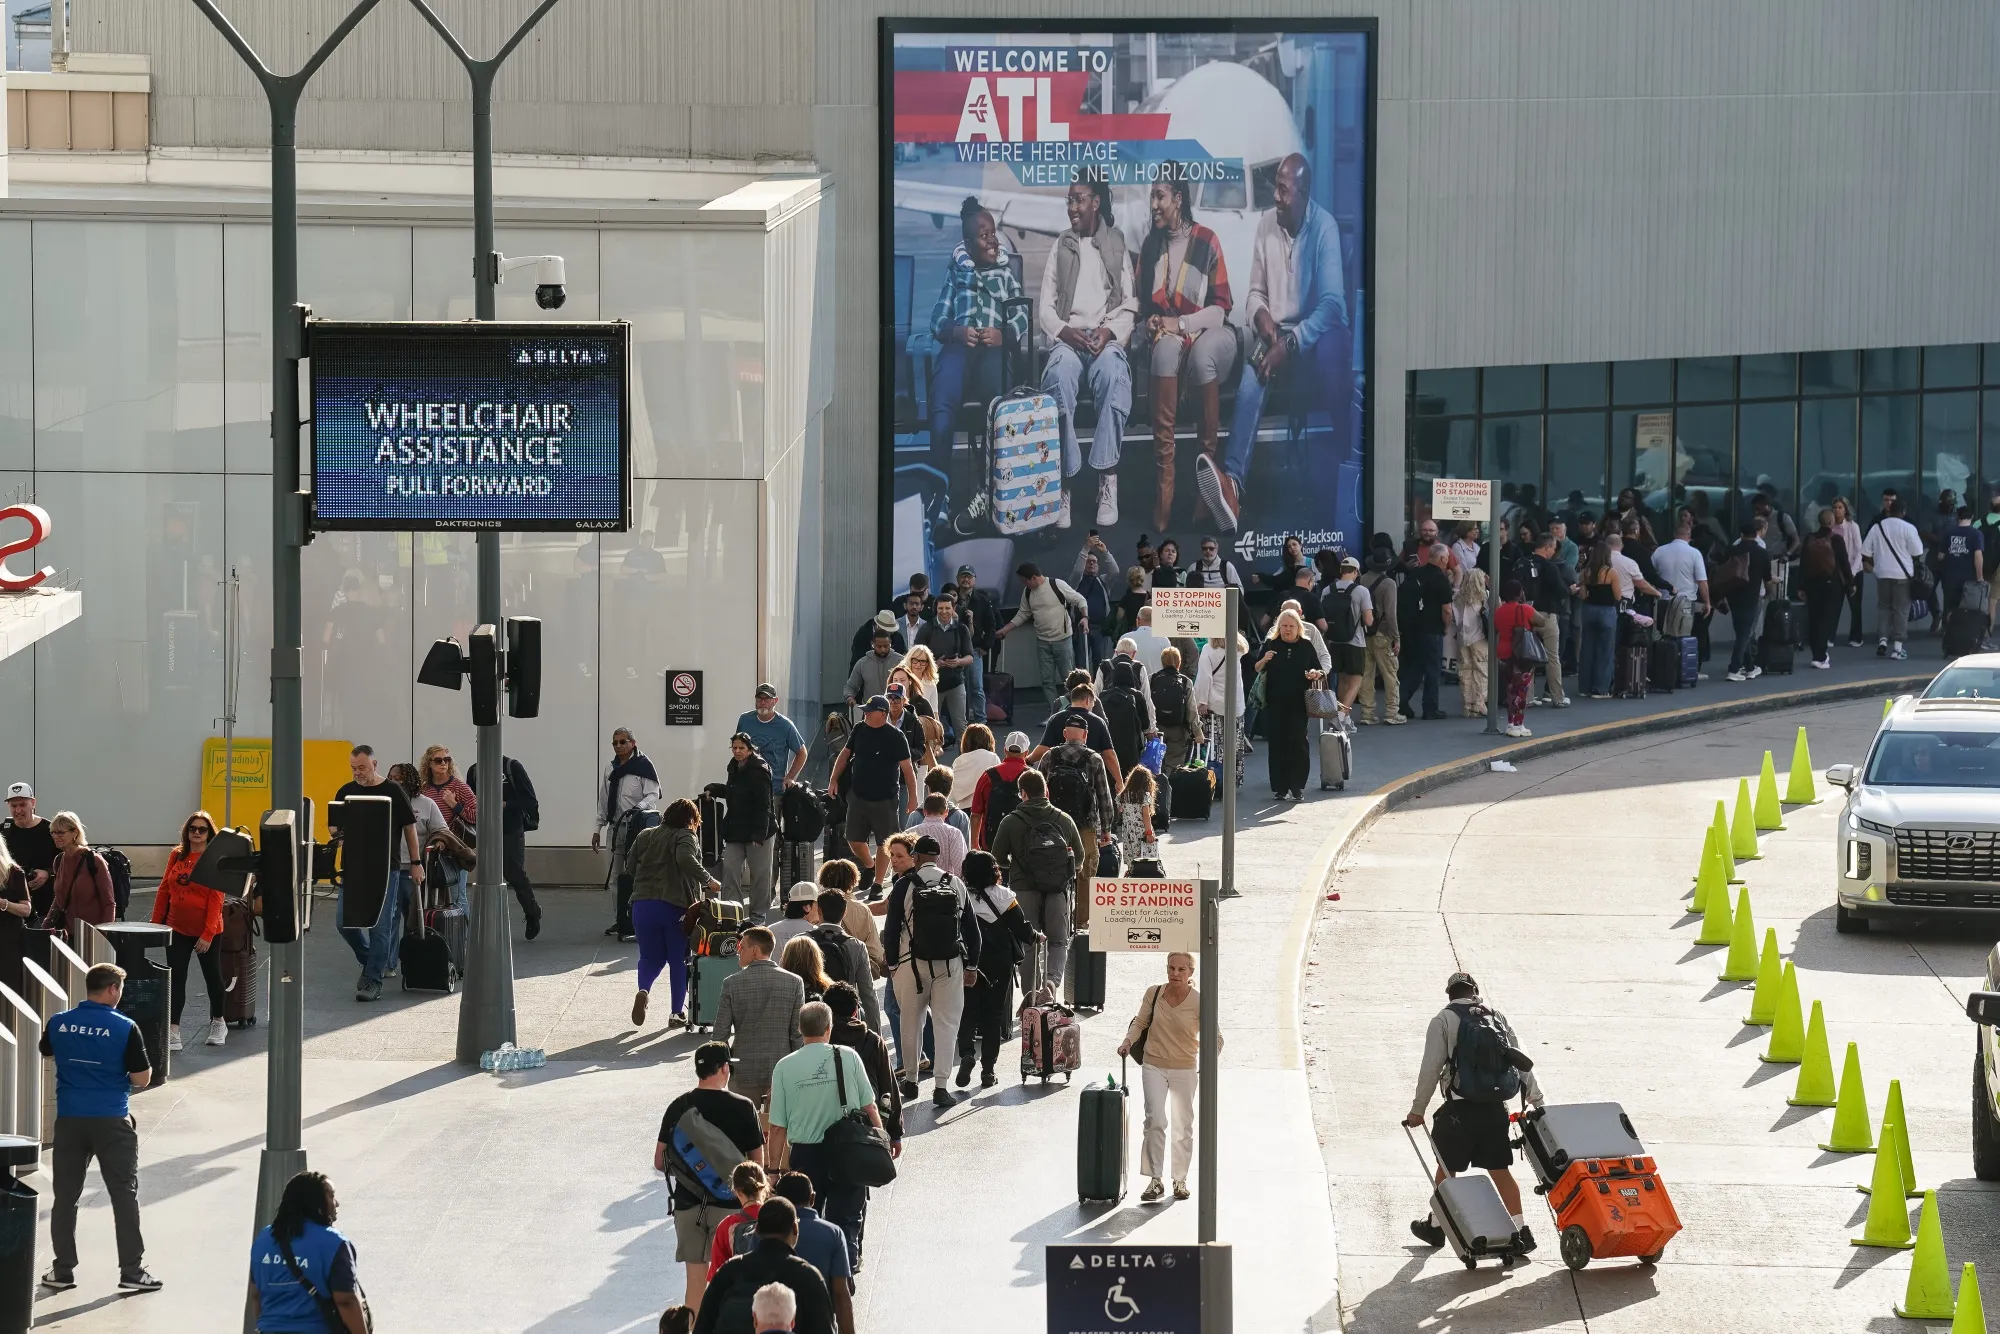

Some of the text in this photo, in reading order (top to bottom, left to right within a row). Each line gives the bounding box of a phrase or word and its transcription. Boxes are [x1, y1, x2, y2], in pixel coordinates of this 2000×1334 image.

[954, 50, 1108, 72] WELCOME TO
[955, 77, 1070, 142] ATL
[958, 141, 1118, 162] WHERE HERITAGE
[1021, 161, 1240, 184] MEETS NEW HORIZONS...
[364, 402, 572, 430] WHEELCHAIR
[374, 436, 564, 465] ASSISTANCE
[386, 475, 553, 496] PULL FORWARD
[435, 520, 502, 528] DAKTRONICS
[575, 521, 616, 529] GALAXY
[1256, 529, 1344, 547] Hartsfld-Jackson
[1256, 549, 1279, 558] Atlanta
[1156, 591, 1222, 599] NO STOPPING
[1155, 599, 1222, 608] OR STANDING
[668, 703, 701, 711] SMOKING
[1096, 883, 1193, 894] NO STOPPING
[1095, 896, 1194, 907] OR STANDING
[1110, 909, 1138, 917] Except
[1104, 916, 1136, 924] Loading
[1144, 916, 1184, 924] Unloading
[70, 1024, 110, 1037] DELTA
[273, 1254, 309, 1268] DTA
[1091, 1254, 1156, 1268] DELTA
